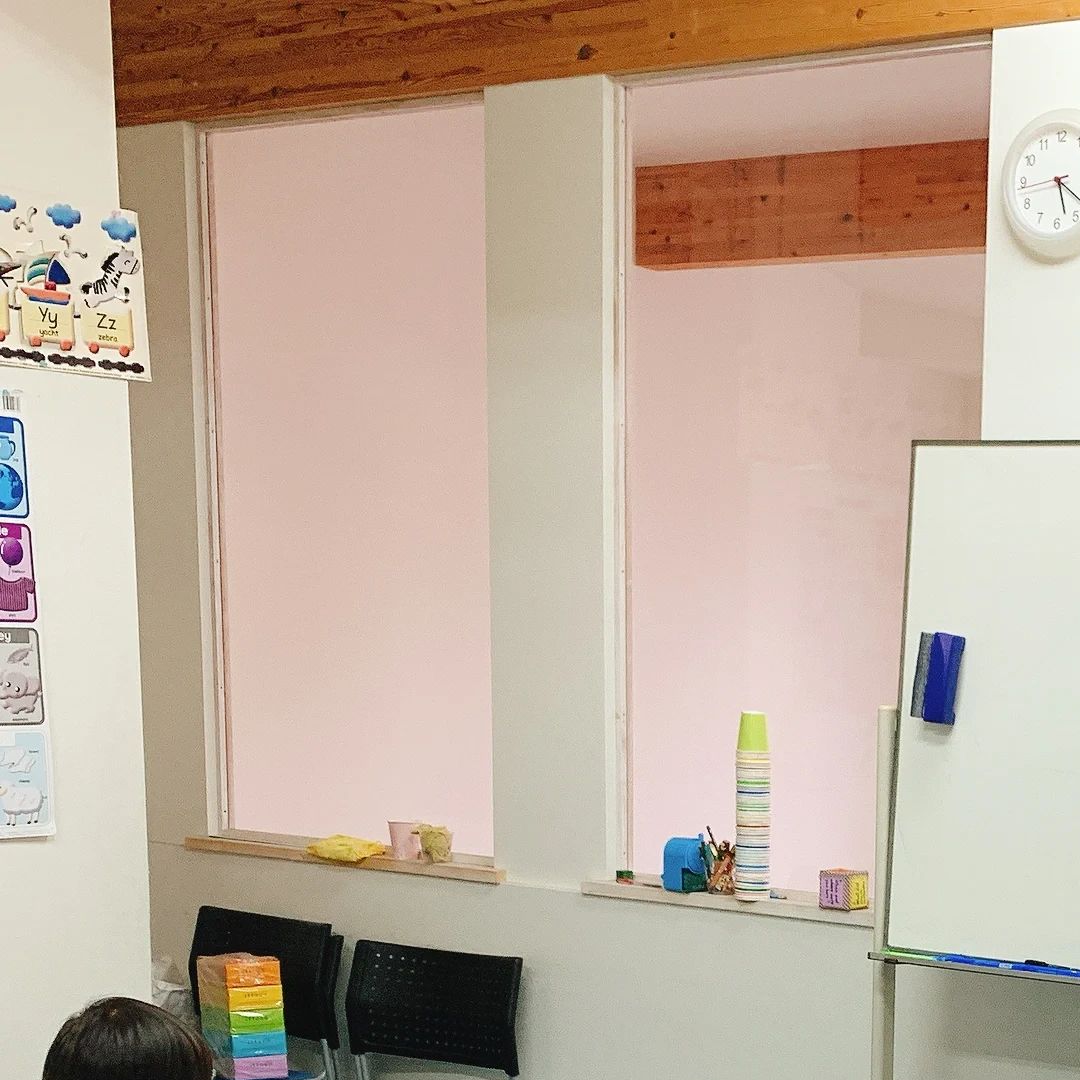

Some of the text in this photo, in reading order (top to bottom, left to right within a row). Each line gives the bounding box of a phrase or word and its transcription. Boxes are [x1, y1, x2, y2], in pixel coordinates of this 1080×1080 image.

[1056, 130, 1067, 143] 12
[1040, 139, 1049, 151] 11
[1025, 153, 1036, 167] 10
[1019, 176, 1027, 189] 9
[1023, 197, 1031, 210] 8
[1037, 212, 1044, 224] 7
[1072, 210, 1080, 223] 5
[1053, 217, 1061, 230] 6
[38, 306, 58, 329] Yy
[96, 312, 117, 330] Zz
[98, 334, 118, 342] zebra
